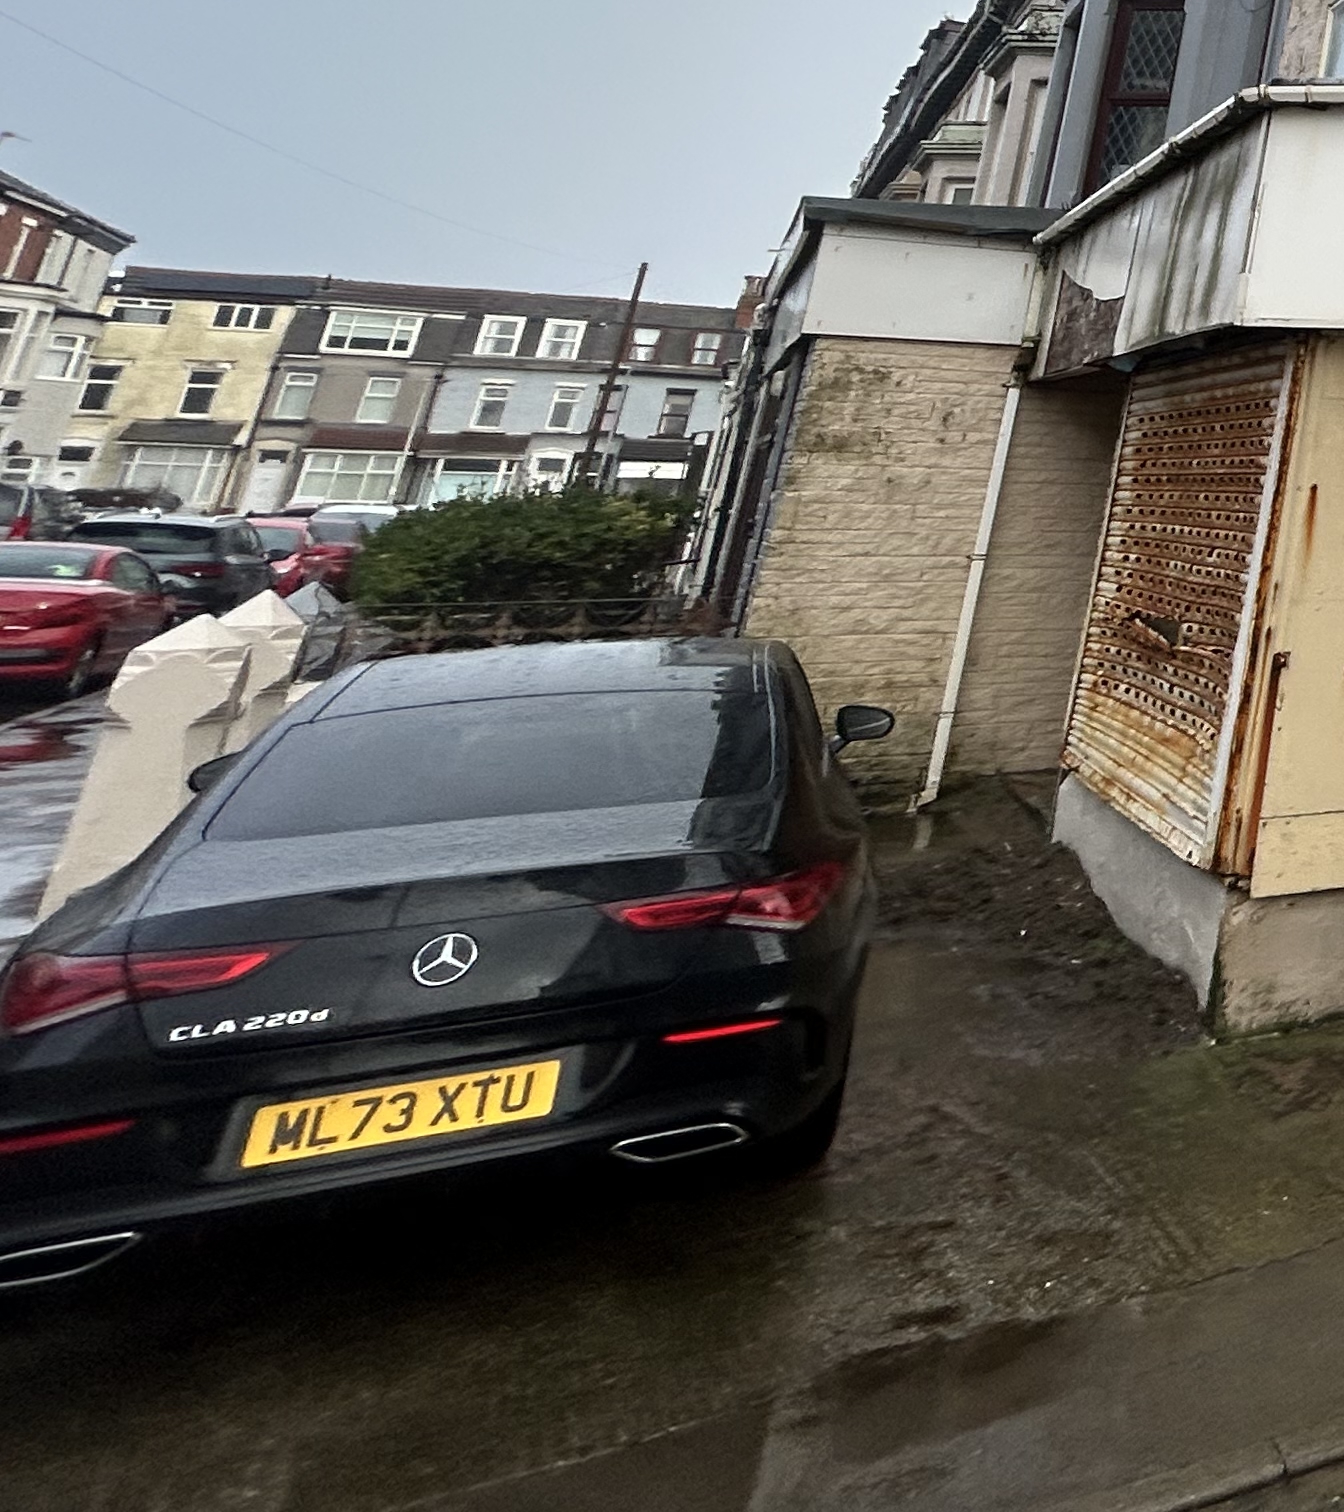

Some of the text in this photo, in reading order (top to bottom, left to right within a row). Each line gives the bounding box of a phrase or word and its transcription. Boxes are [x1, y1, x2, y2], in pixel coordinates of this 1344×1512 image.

[168, 1008, 330, 1042] CLA 220d
[268, 1070, 536, 1155] ML73 XTU
